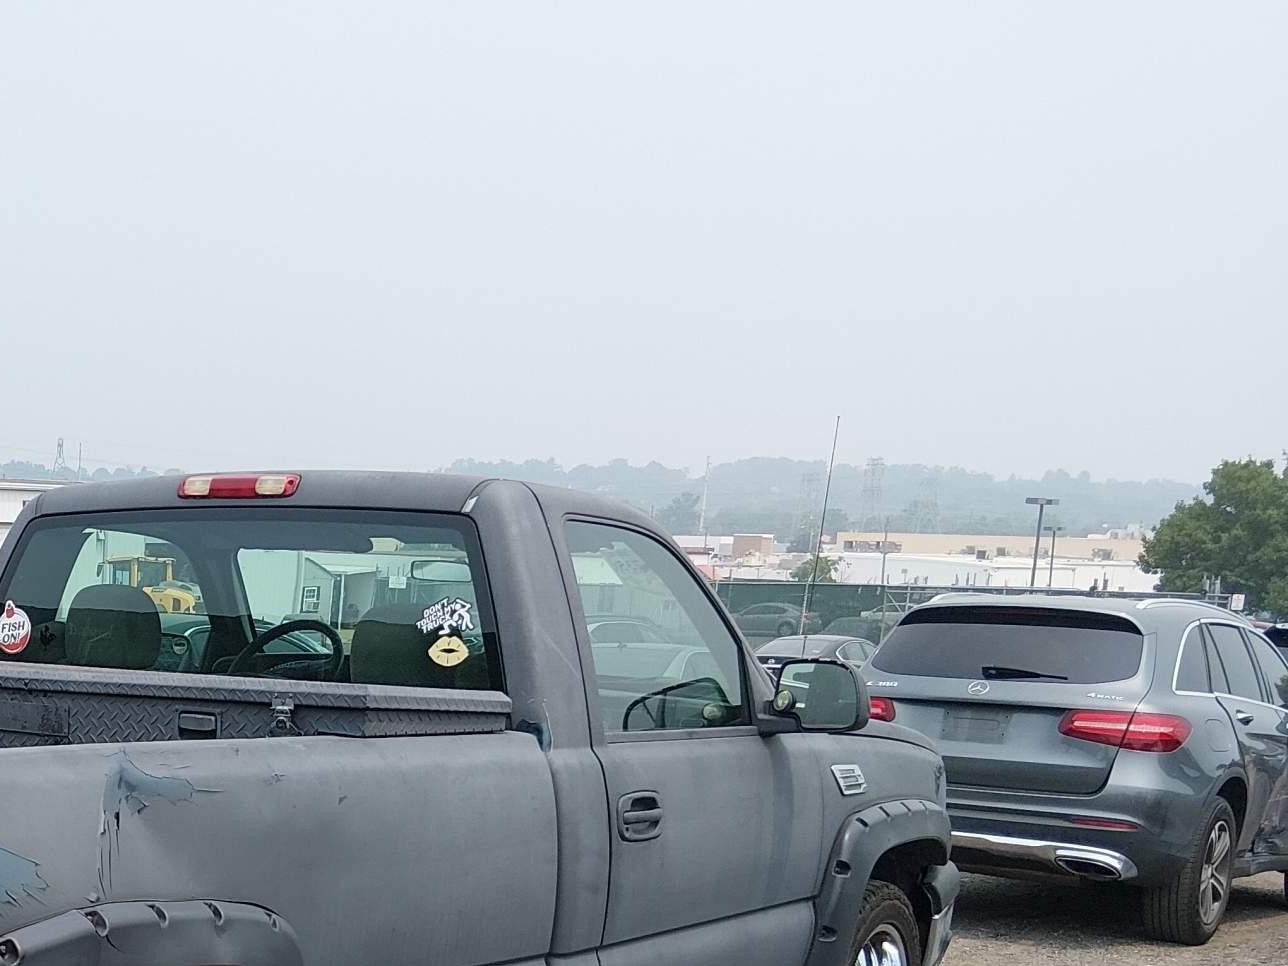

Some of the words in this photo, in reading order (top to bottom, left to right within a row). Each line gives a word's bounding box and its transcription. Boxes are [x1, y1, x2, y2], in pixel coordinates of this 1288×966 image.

[416, 608, 443, 629] TOUCH
[421, 613, 452, 634] TRUCK
[2, 621, 25, 634] FISH
[2, 632, 20, 643] ON!
